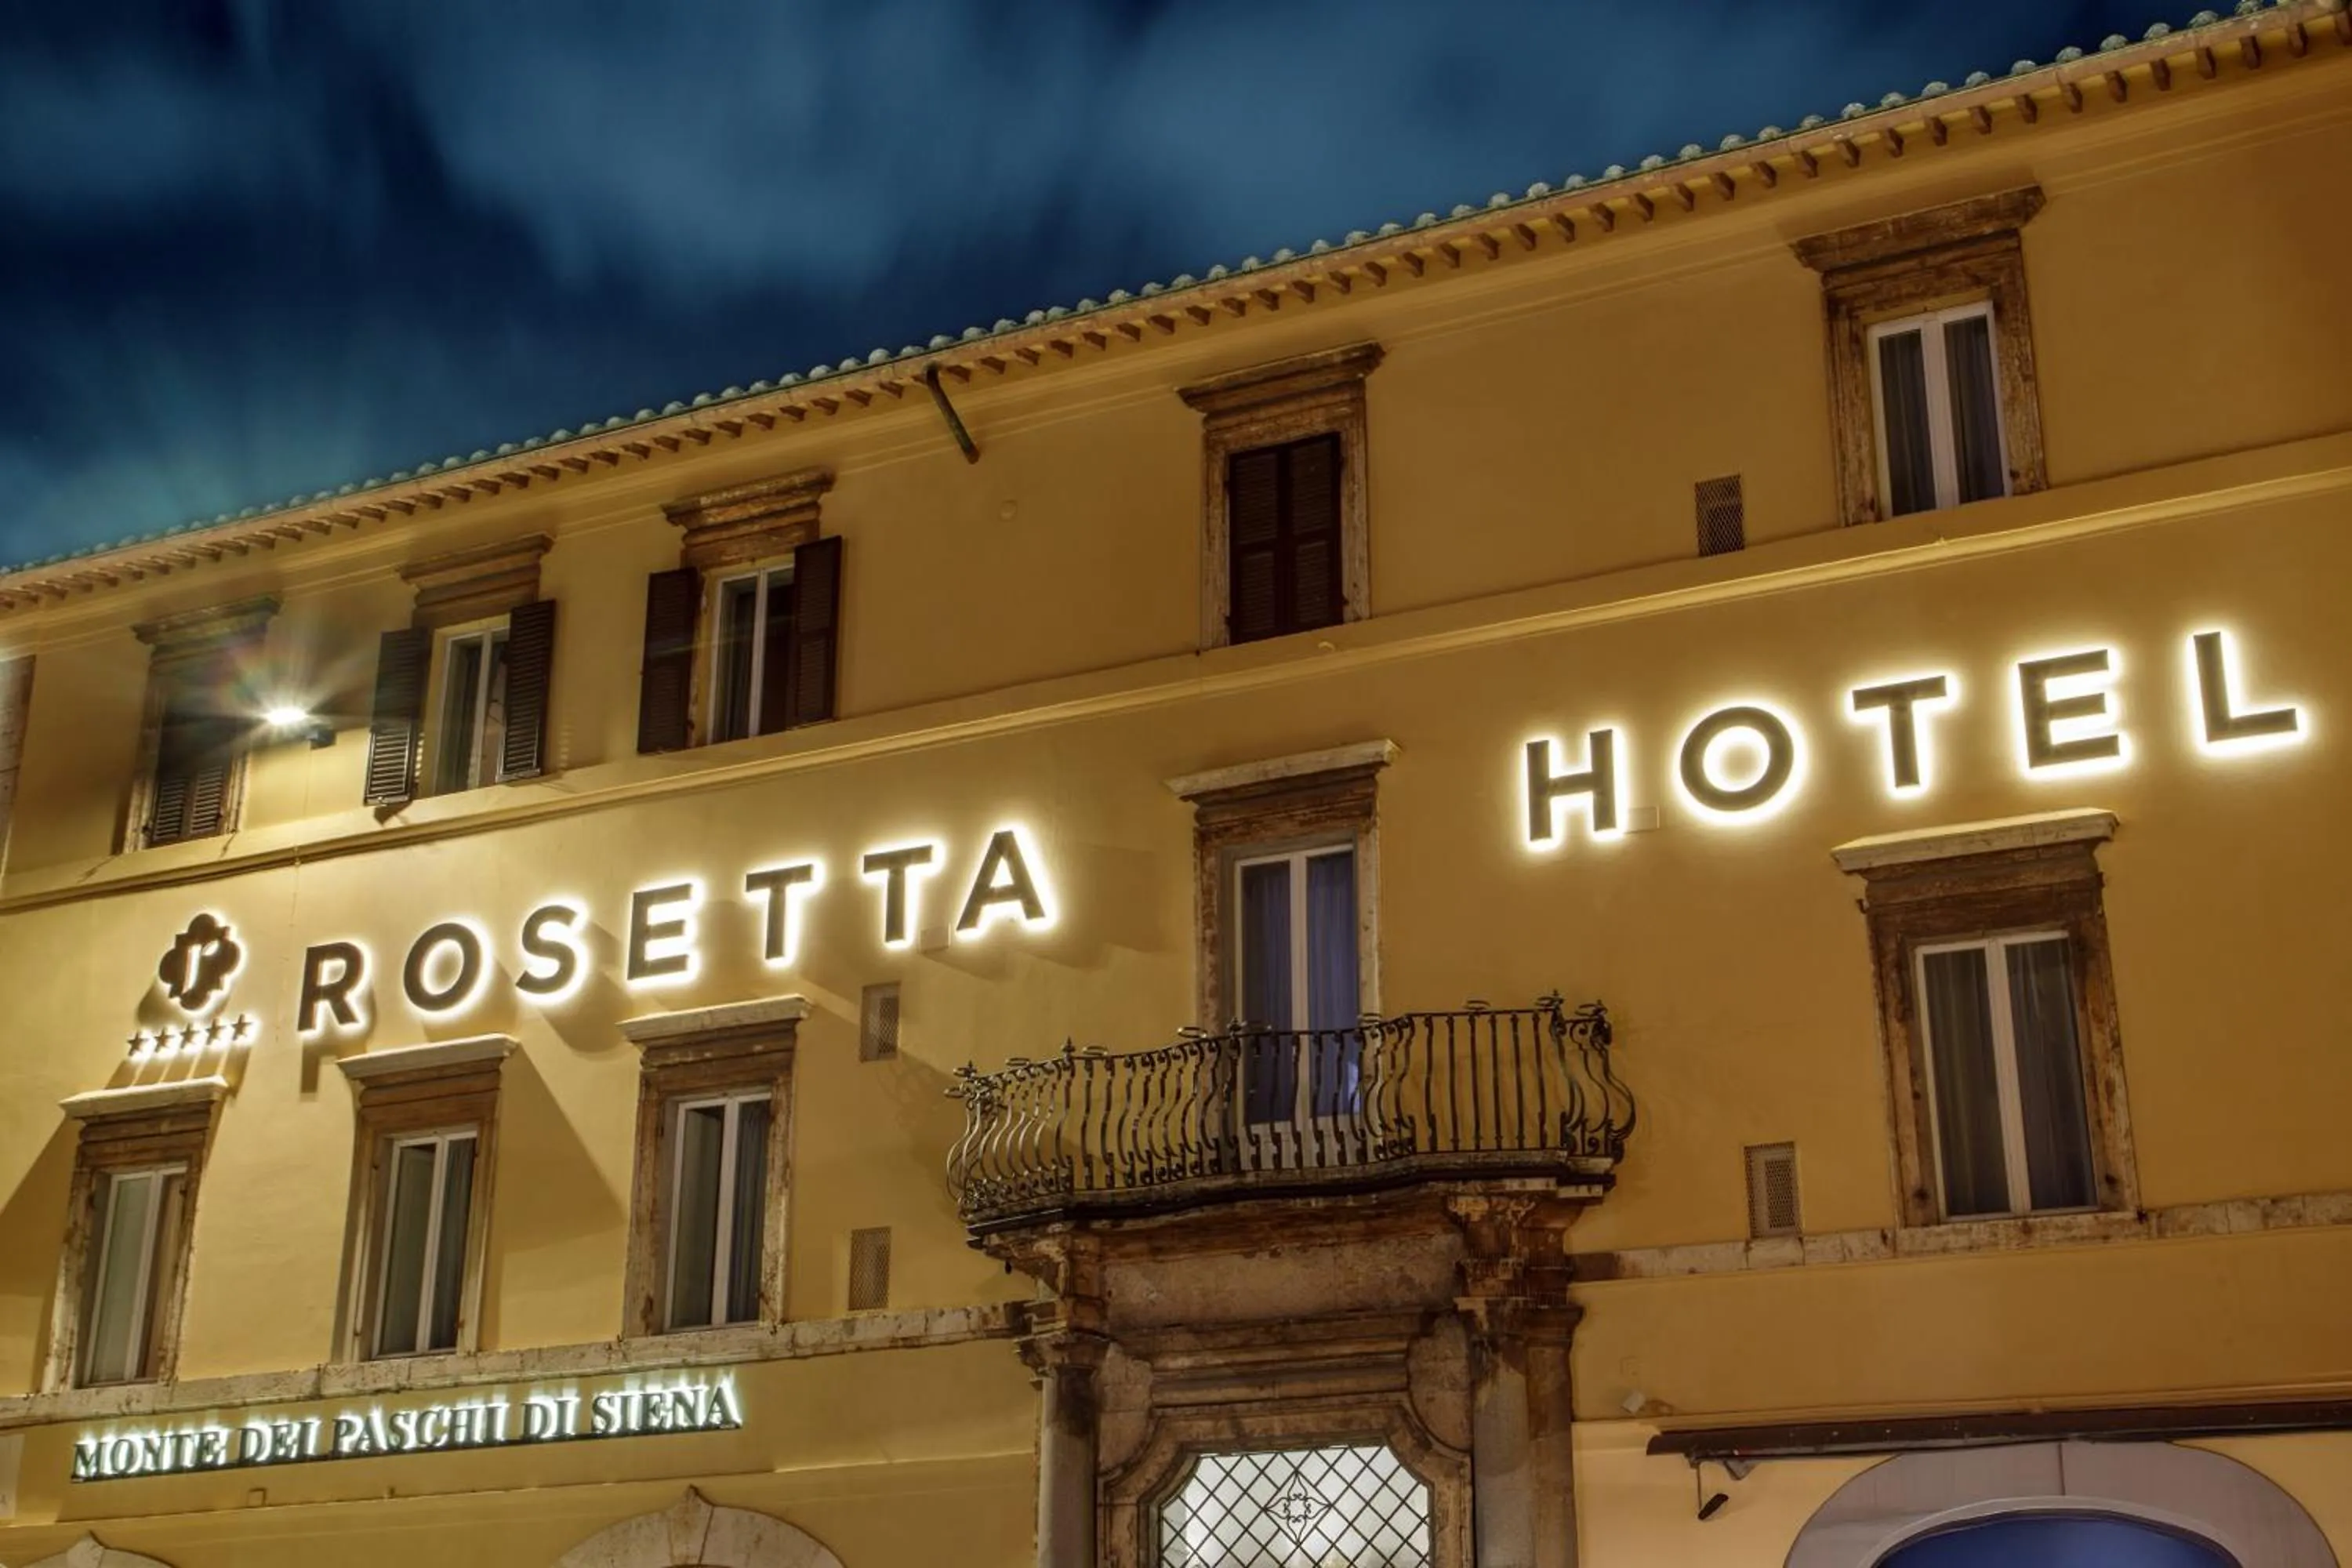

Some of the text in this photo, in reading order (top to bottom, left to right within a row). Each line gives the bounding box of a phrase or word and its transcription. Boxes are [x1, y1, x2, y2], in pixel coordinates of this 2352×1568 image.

[296, 631, 2299, 1032] ROSETTA HOTEL
[73, 1382, 741, 1479] MONTE DEI PASCHI DI SIENA
